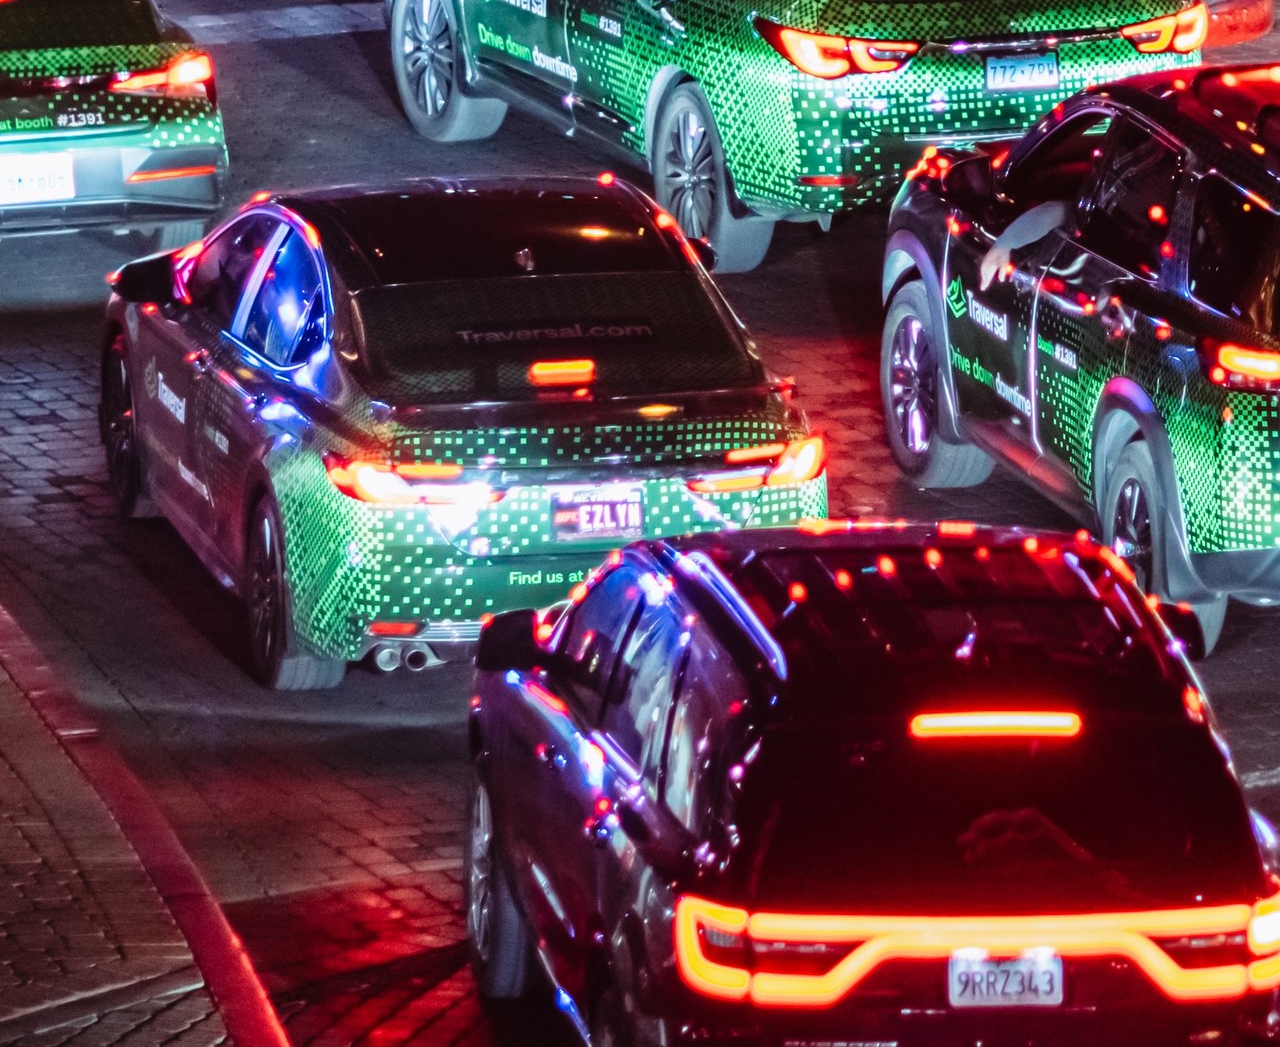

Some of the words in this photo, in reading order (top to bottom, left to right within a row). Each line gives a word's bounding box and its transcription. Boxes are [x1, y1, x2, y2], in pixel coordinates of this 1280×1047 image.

[478, 22, 505, 51] Drive
[506, 34, 531, 63] down
[532, 45, 577, 82] downtime
[0, 120, 12, 131] at
[15, 116, 54, 129] booth
[57, 112, 105, 127] #1391
[966, 289, 1007, 341] Traversal
[456, 324, 653, 343] Traversal.com
[1055, 343, 1077, 369] #1391
[972, 357, 994, 388] down
[995, 372, 1032, 417] downtime
[509, 570, 542, 585] Find
[546, 572, 564, 584] us
[568, 570, 584, 583] at
